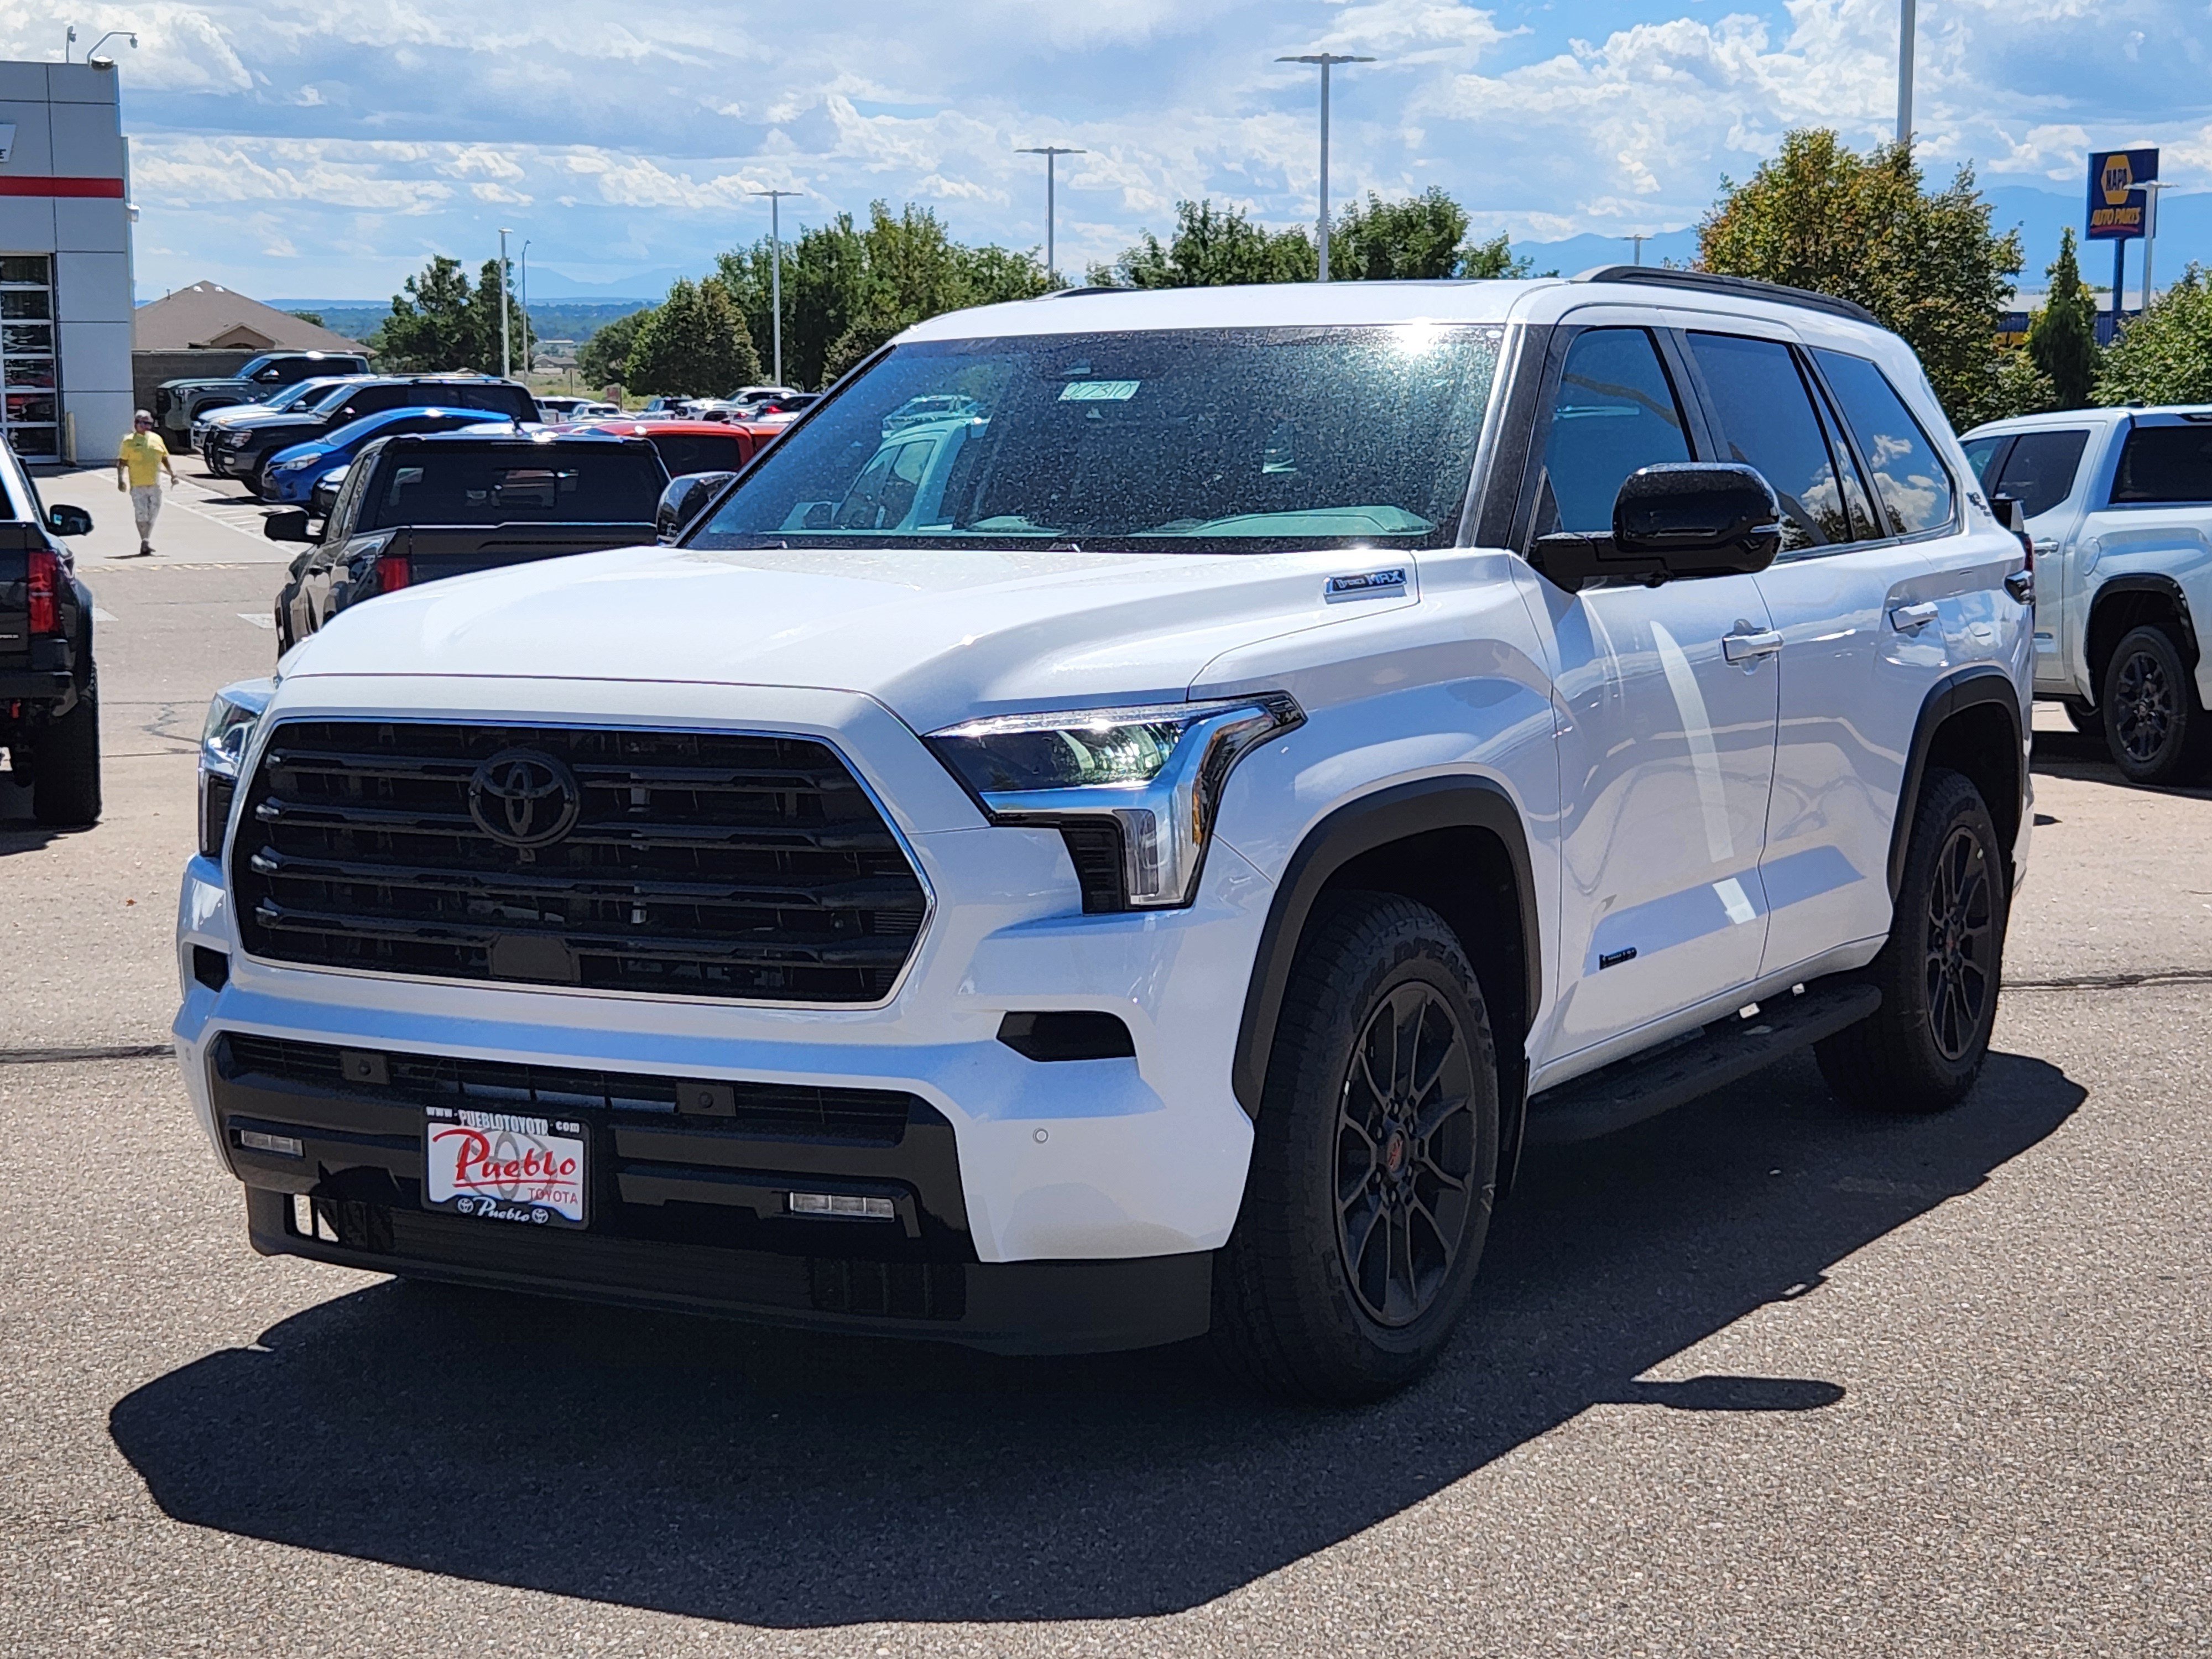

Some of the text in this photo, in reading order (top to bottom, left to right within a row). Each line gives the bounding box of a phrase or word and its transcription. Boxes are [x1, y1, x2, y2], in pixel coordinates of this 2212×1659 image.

[2106, 168, 2128, 191] NAPA
[2091, 208, 2141, 226] AUTO PARTS
[1364, 571, 1403, 585] MAX
[432, 1128, 577, 1181] Pueblo
[528, 1187, 578, 1205] TOYOTA
[473, 1196, 530, 1222] Pueblo
